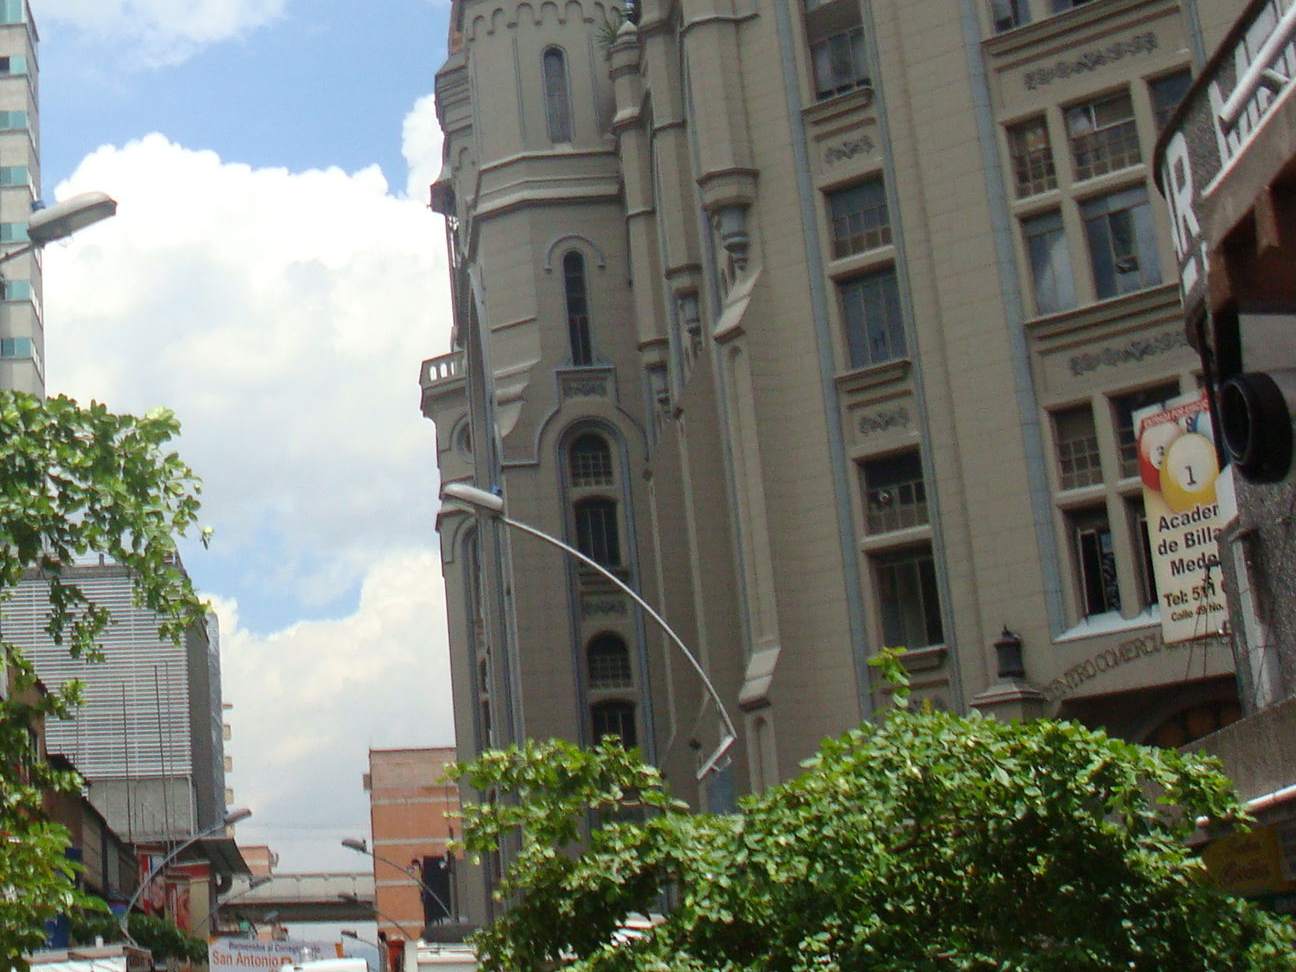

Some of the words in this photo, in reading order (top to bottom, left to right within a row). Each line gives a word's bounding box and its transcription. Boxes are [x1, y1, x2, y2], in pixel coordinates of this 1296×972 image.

[1184, 464, 1197, 486] 1
[1158, 538, 1178, 556] de
[1163, 589, 1189, 607] Tel:
[212, 949, 233, 966] San
[236, 951, 279, 967] Antonio
